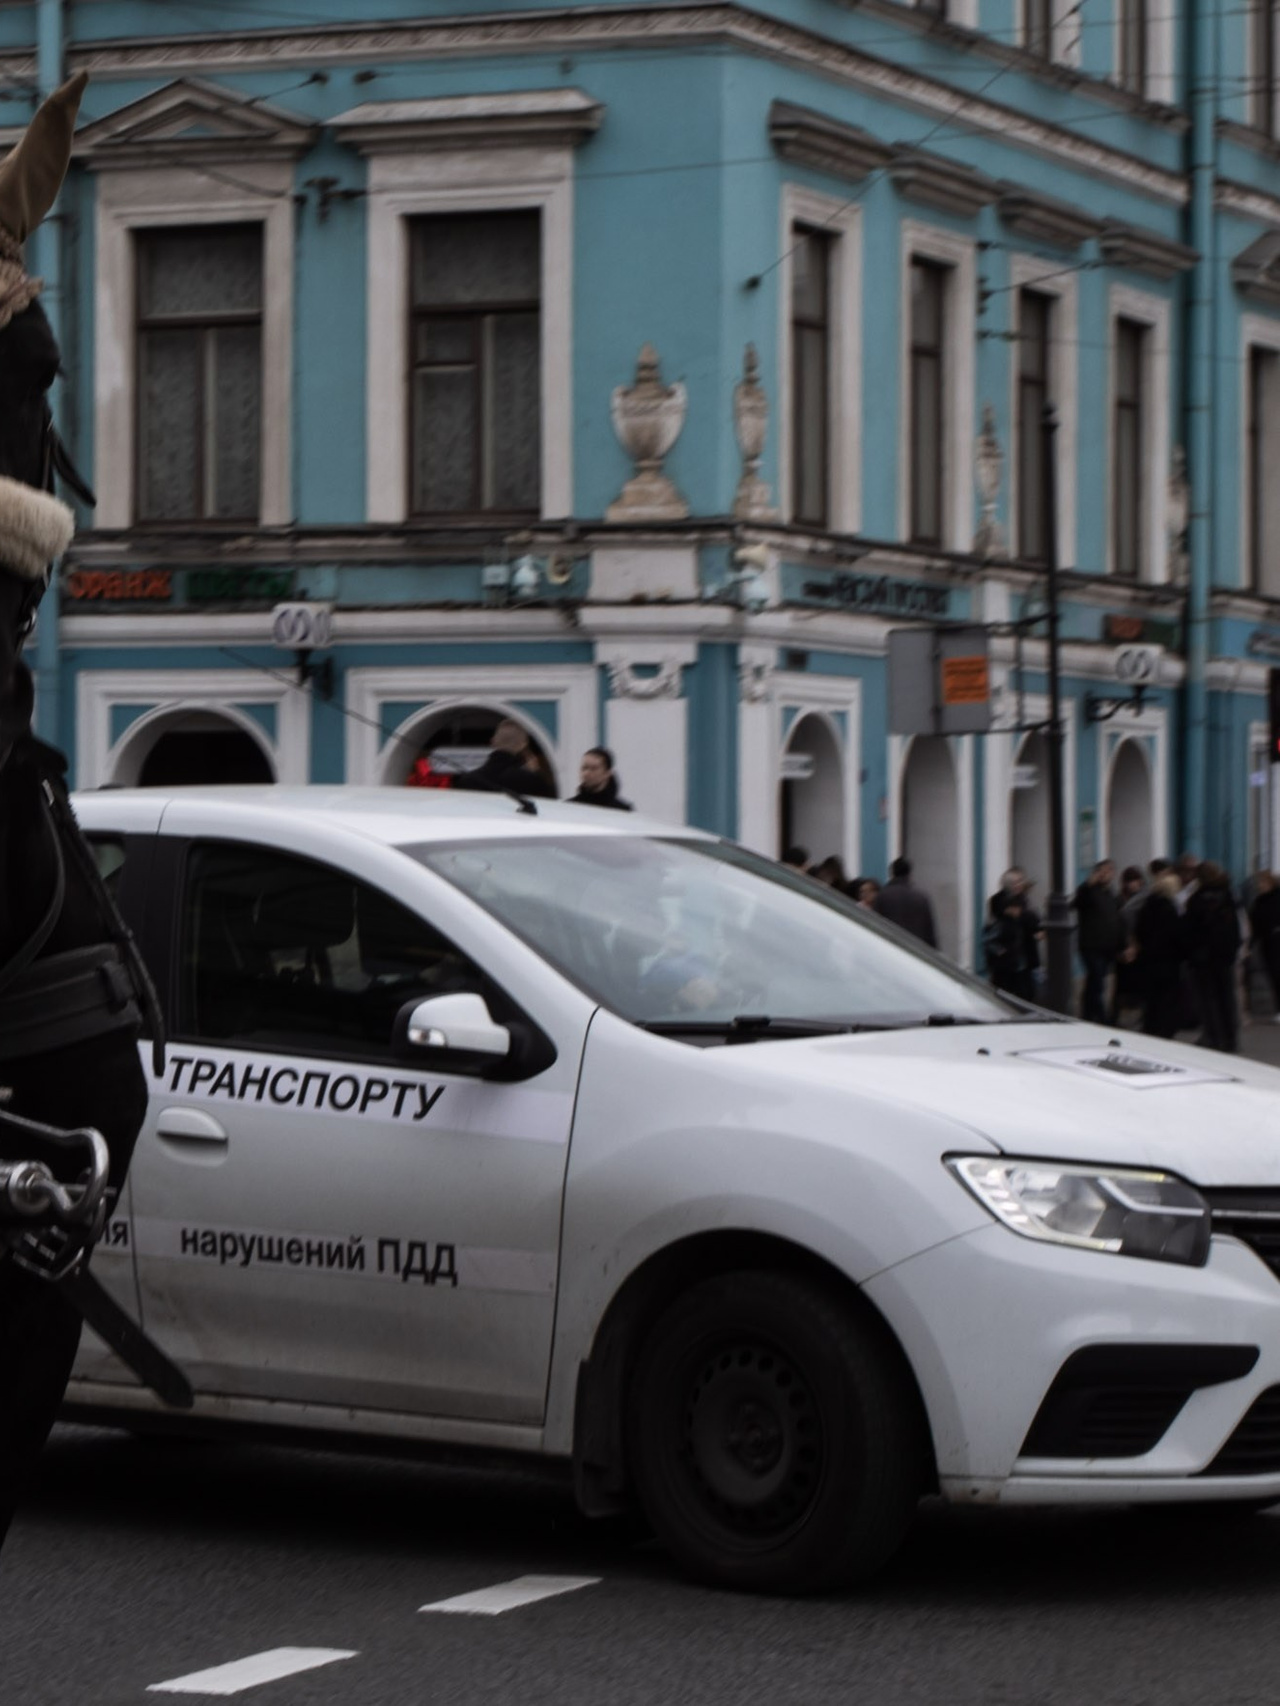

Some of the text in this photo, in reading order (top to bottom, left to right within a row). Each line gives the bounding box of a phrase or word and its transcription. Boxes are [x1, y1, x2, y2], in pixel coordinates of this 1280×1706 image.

[168, 1055, 447, 1121] ТРАНСПОРТУ
[180, 1227, 365, 1271] нарушений
[377, 1237, 458, 1287] ПДД
